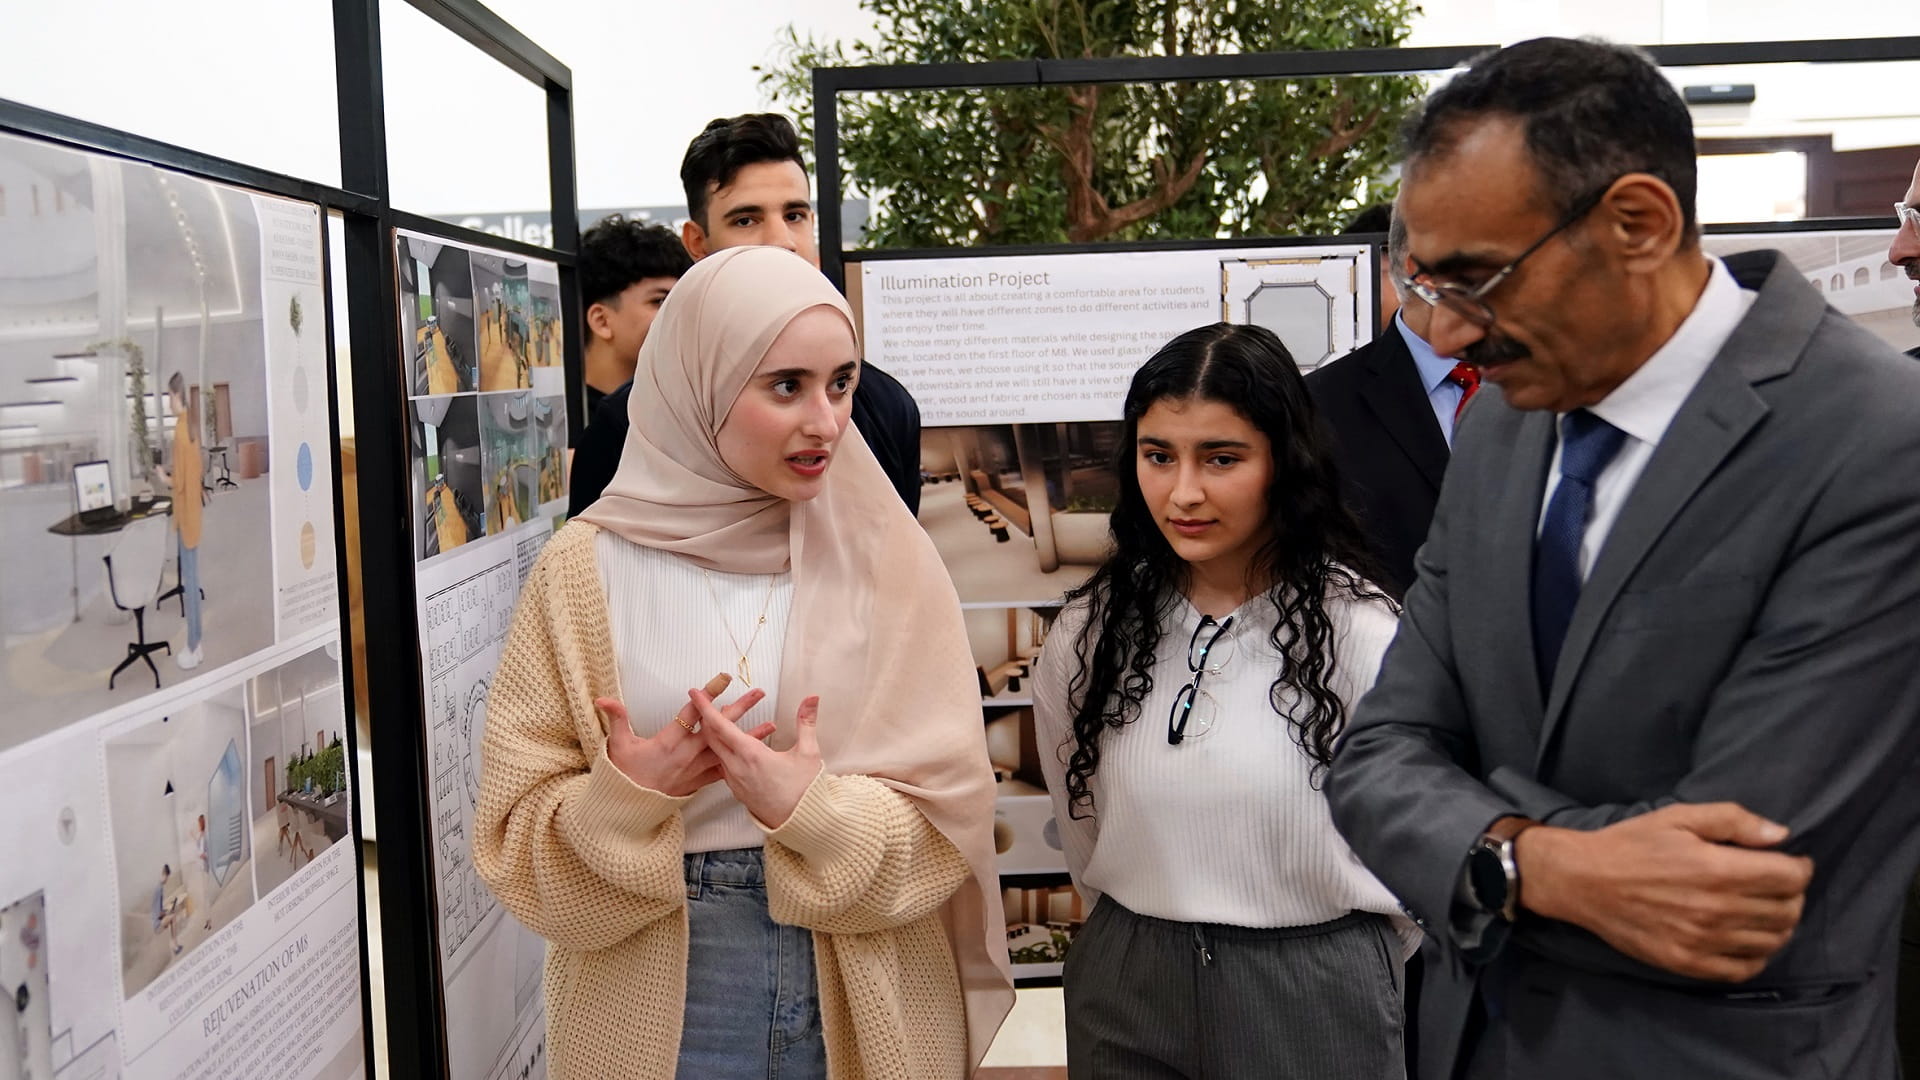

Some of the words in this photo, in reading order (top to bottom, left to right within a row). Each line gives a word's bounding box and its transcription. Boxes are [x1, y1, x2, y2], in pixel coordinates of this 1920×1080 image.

[881, 273, 983, 291] Illumination
[989, 271, 1050, 290] Project
[882, 295, 902, 305] This
[905, 294, 941, 306] project
[944, 294, 952, 302] is
[954, 292, 967, 302] all
[970, 292, 998, 302] about
[1001, 290, 1043, 302] creating
[1053, 288, 1117, 299] comfortable
[1118, 288, 1141, 297] area
[1143, 286, 1157, 296] for
[1160, 286, 1205, 296] students
[882, 310, 913, 320] where
[915, 309, 938, 321] they
[941, 308, 958, 318] will
[960, 307, 985, 317] have
[987, 305, 1031, 316] different
[1034, 305, 1064, 315] zones
[1066, 304, 1077, 313] to
[1079, 303, 1093, 313] do
[1095, 302, 1140, 312] different
[1142, 300, 1188, 311] activities
[1190, 300, 1209, 309] and
[882, 324, 904, 334] also
[905, 323, 933, 335] enjoy
[936, 322, 960, 332] their
[883, 338, 899, 348] We
[901, 337, 931, 347] chose
[934, 337, 961, 349] many
[963, 335, 1008, 346] different
[1010, 333, 1058, 344] materials
[1060, 332, 1087, 342] while
[1090, 330, 1138, 343] designing
[1140, 329, 1157, 339] the
[883, 353, 911, 364] have,
[913, 352, 951, 362] located
[953, 353, 967, 361] on
[969, 351, 986, 361] the
[988, 350, 1009, 360] first
[1011, 349, 1036, 359] floor
[1038, 348, 1049, 358] of
[1072, 347, 1089, 357] We
[1091, 346, 1114, 356] used
[1117, 345, 1142, 357] glass
[911, 368, 927, 377] we
[958, 366, 971, 375] we
[974, 364, 1011, 375] choose
[1013, 363, 1042, 375] using
[1042, 362, 1050, 372] it
[1052, 363, 1064, 372] so
[1066, 361, 1087, 371] that
[1089, 360, 1106, 370] the
[916, 380, 972, 391] downstairs
[974, 379, 993, 389] and
[995, 379, 1010, 388] we
[1012, 377, 1030, 387] will
[1032, 376, 1050, 386] still
[1052, 375, 1078, 385] have
[1088, 374, 1110, 384] view
[1113, 374, 1125, 384] of
[939, 394, 967, 405] wood
[969, 393, 988, 403] and
[990, 392, 1019, 402] fabric
[1023, 392, 1039, 401] are
[1041, 390, 1078, 400] chosen
[1080, 391, 1091, 399] as
[936, 410, 953, 420] the
[956, 408, 987, 419] sound
[203, 956, 279, 1037] REJUVENATION
[282, 944, 294, 968] OF
[296, 933, 308, 957] M8
